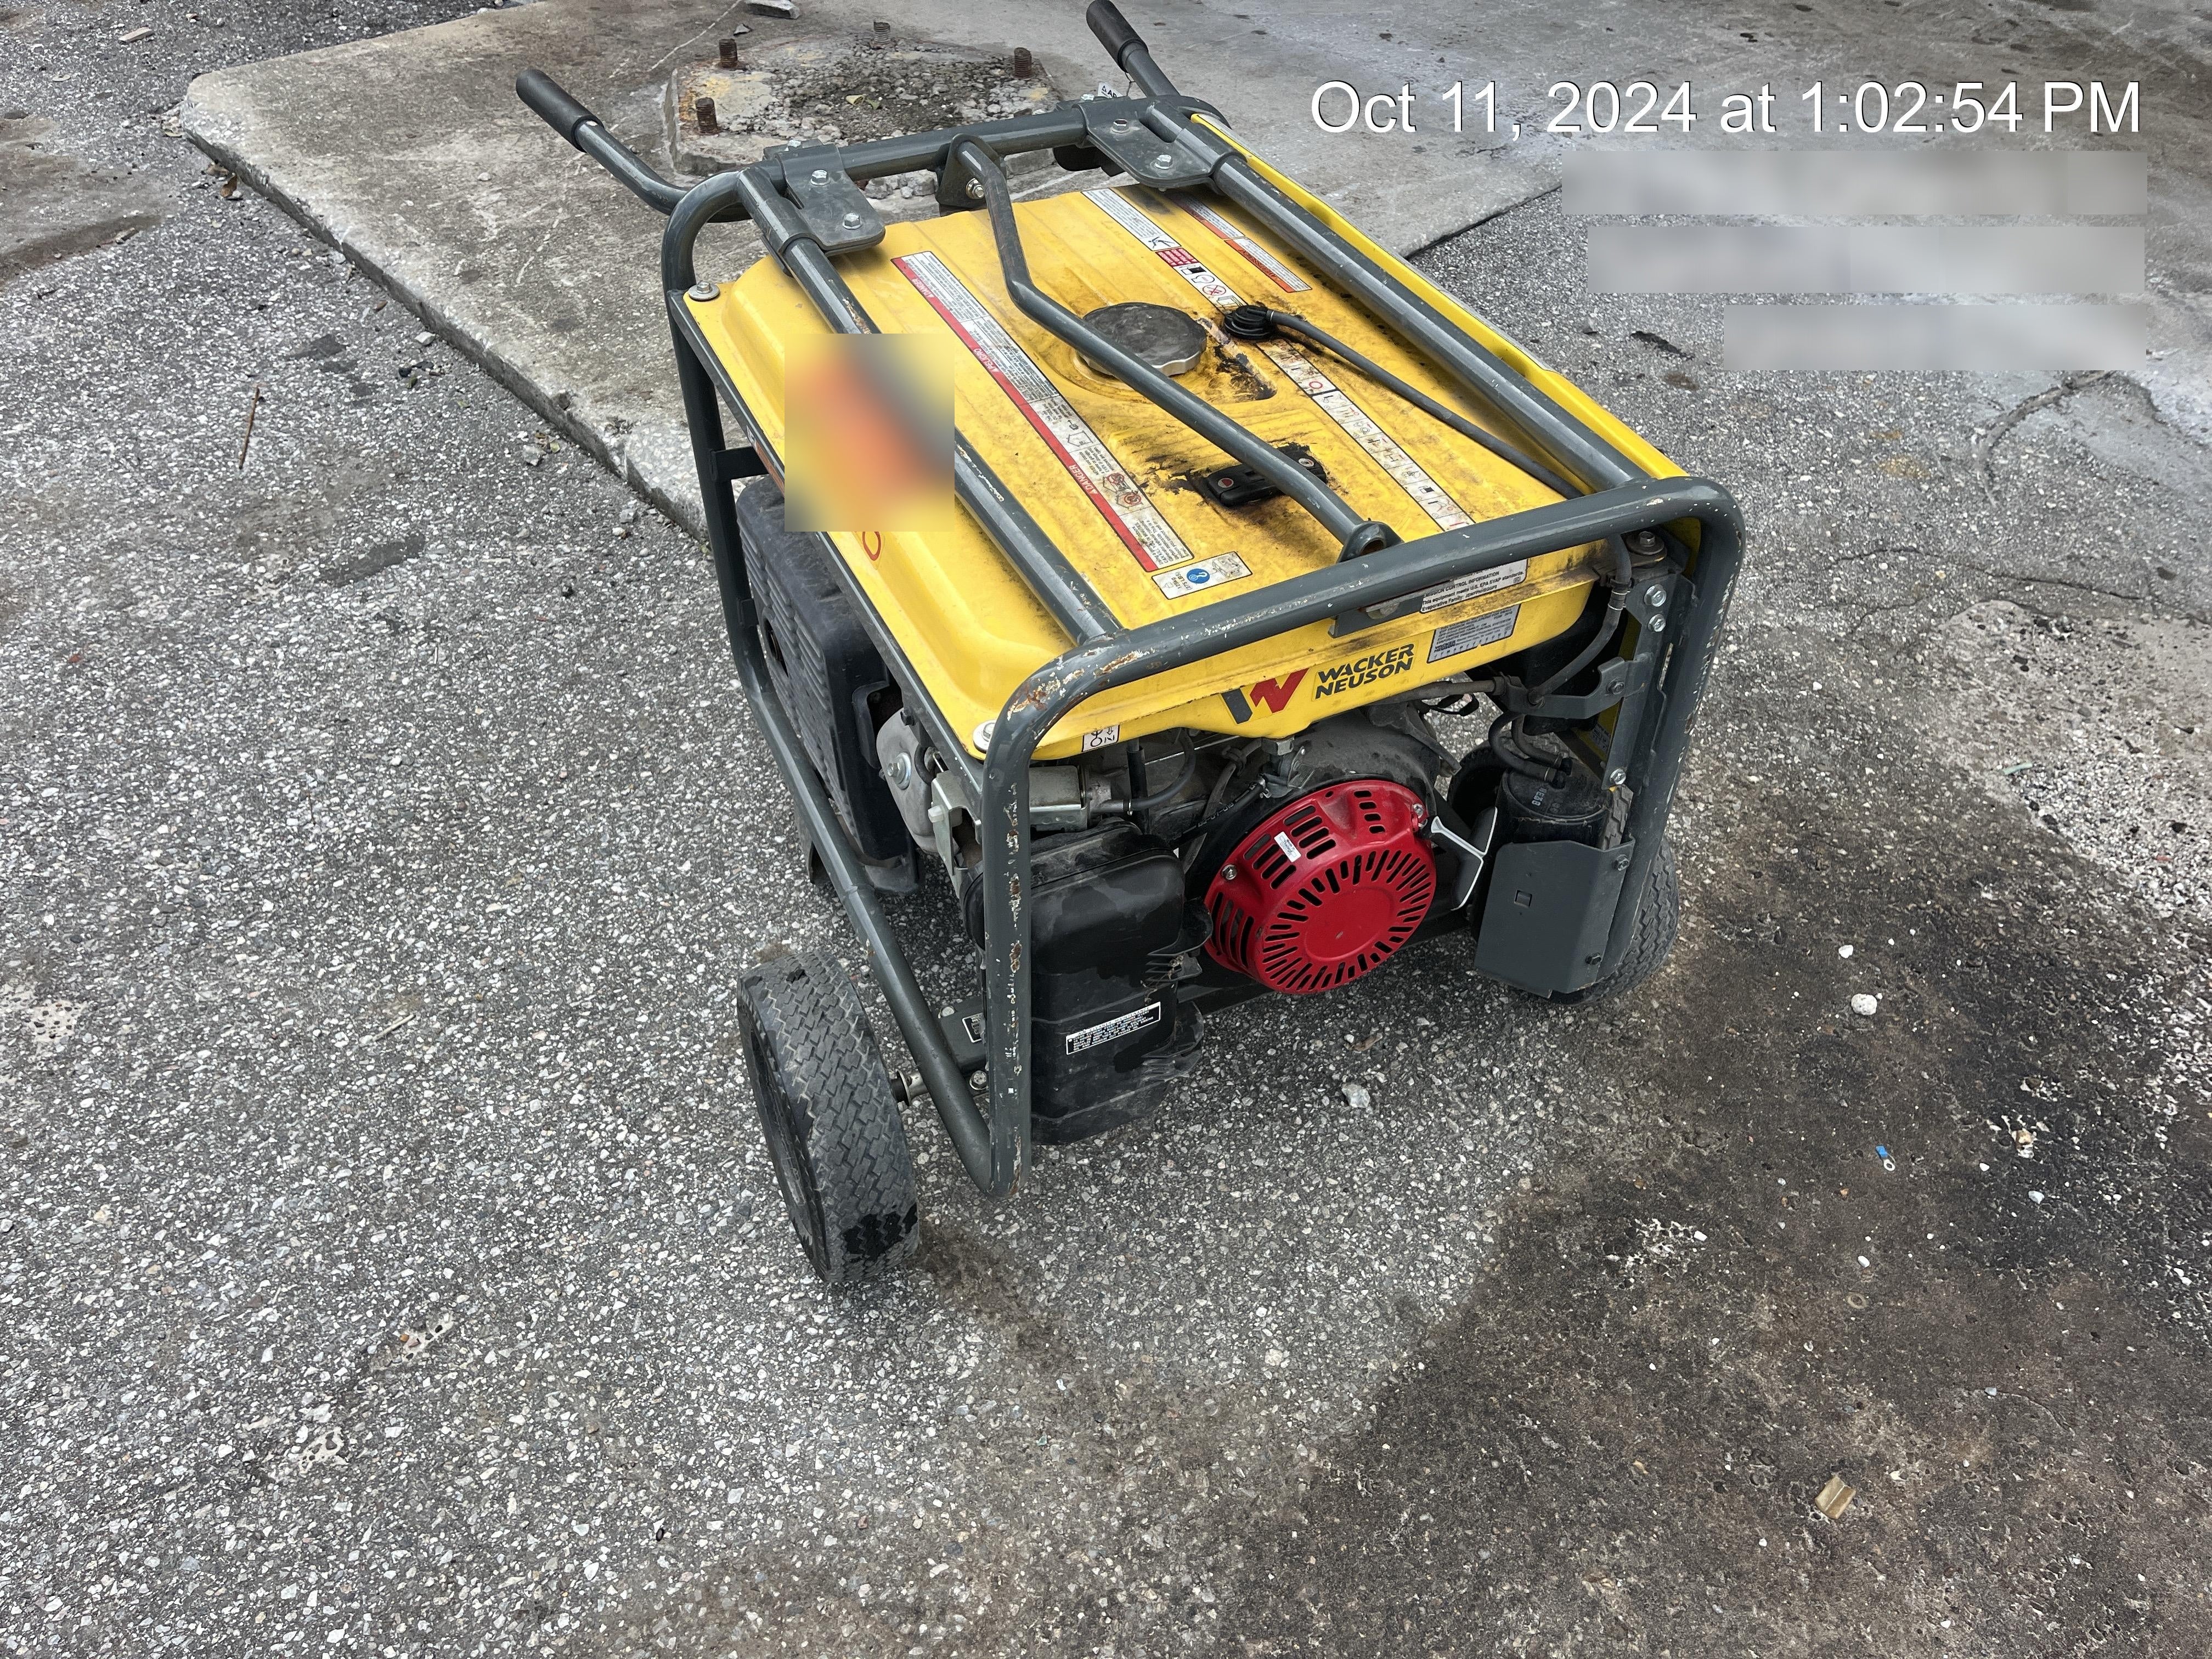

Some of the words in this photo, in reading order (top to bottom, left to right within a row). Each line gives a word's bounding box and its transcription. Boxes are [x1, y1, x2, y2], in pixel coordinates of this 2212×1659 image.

[973, 347, 996, 369] PELIGRO
[1068, 464, 1095, 490] DANGER
[1469, 570, 1499, 584] INFORMATION
[1317, 643, 1414, 683] WACKER
[1315, 657, 1414, 699] NEUSON
